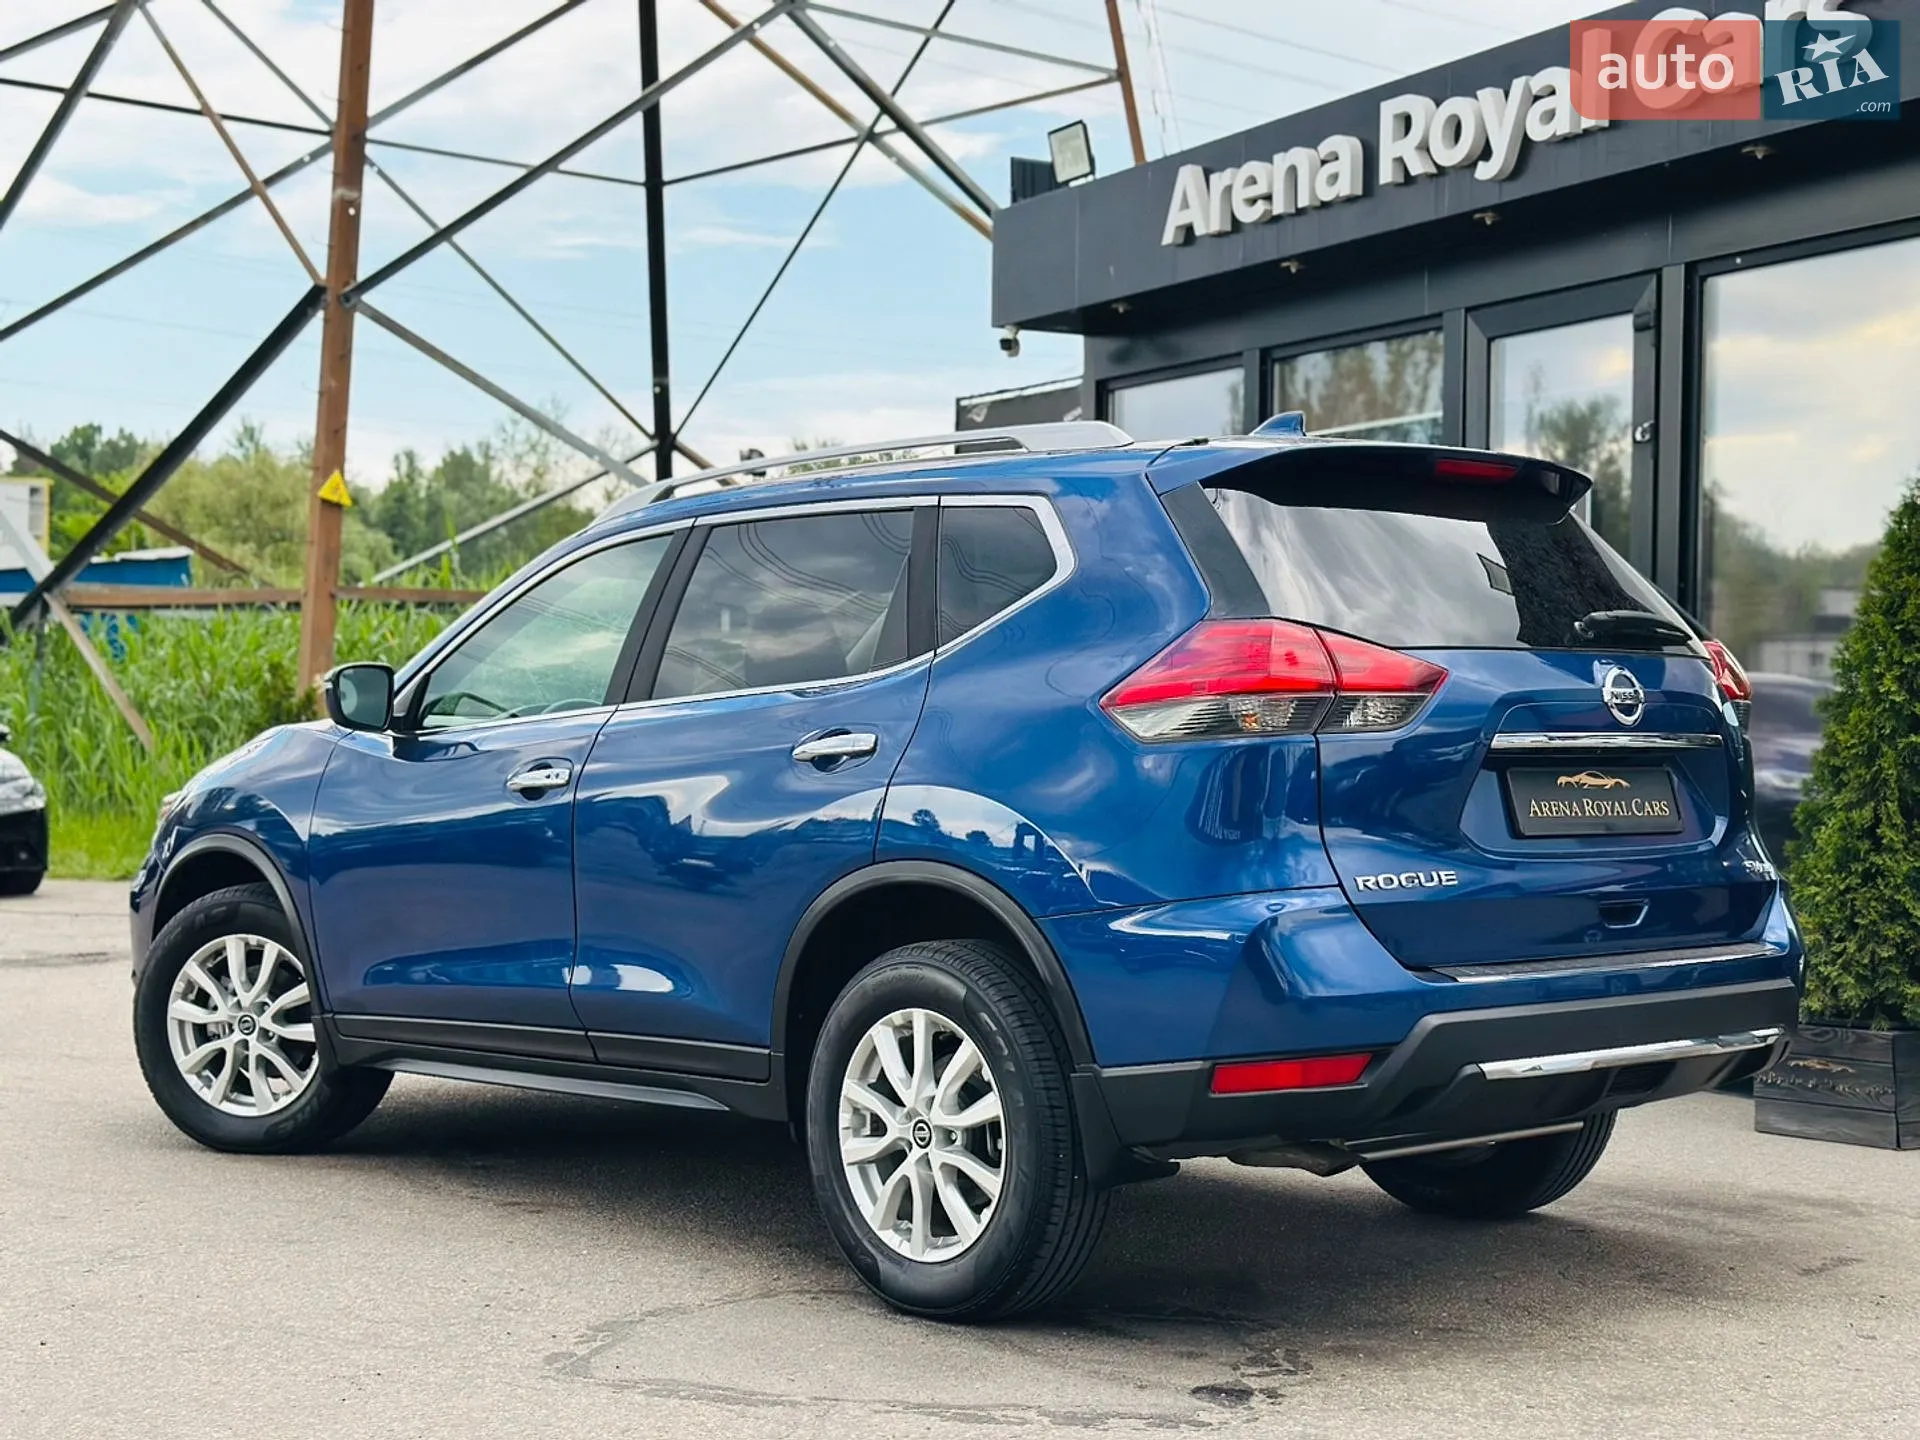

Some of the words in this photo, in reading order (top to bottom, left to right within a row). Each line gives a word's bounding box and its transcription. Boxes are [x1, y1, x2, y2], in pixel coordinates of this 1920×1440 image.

[1161, 133, 1364, 246] Arena
[1378, 28, 1611, 184] Royal
[1631, 0, 1873, 110] Cars
[1529, 799, 1582, 818] ARENA
[1582, 798, 1631, 817] ROYAL
[1631, 798, 1670, 816] CARS
[1354, 871, 1458, 892] ROGUE
